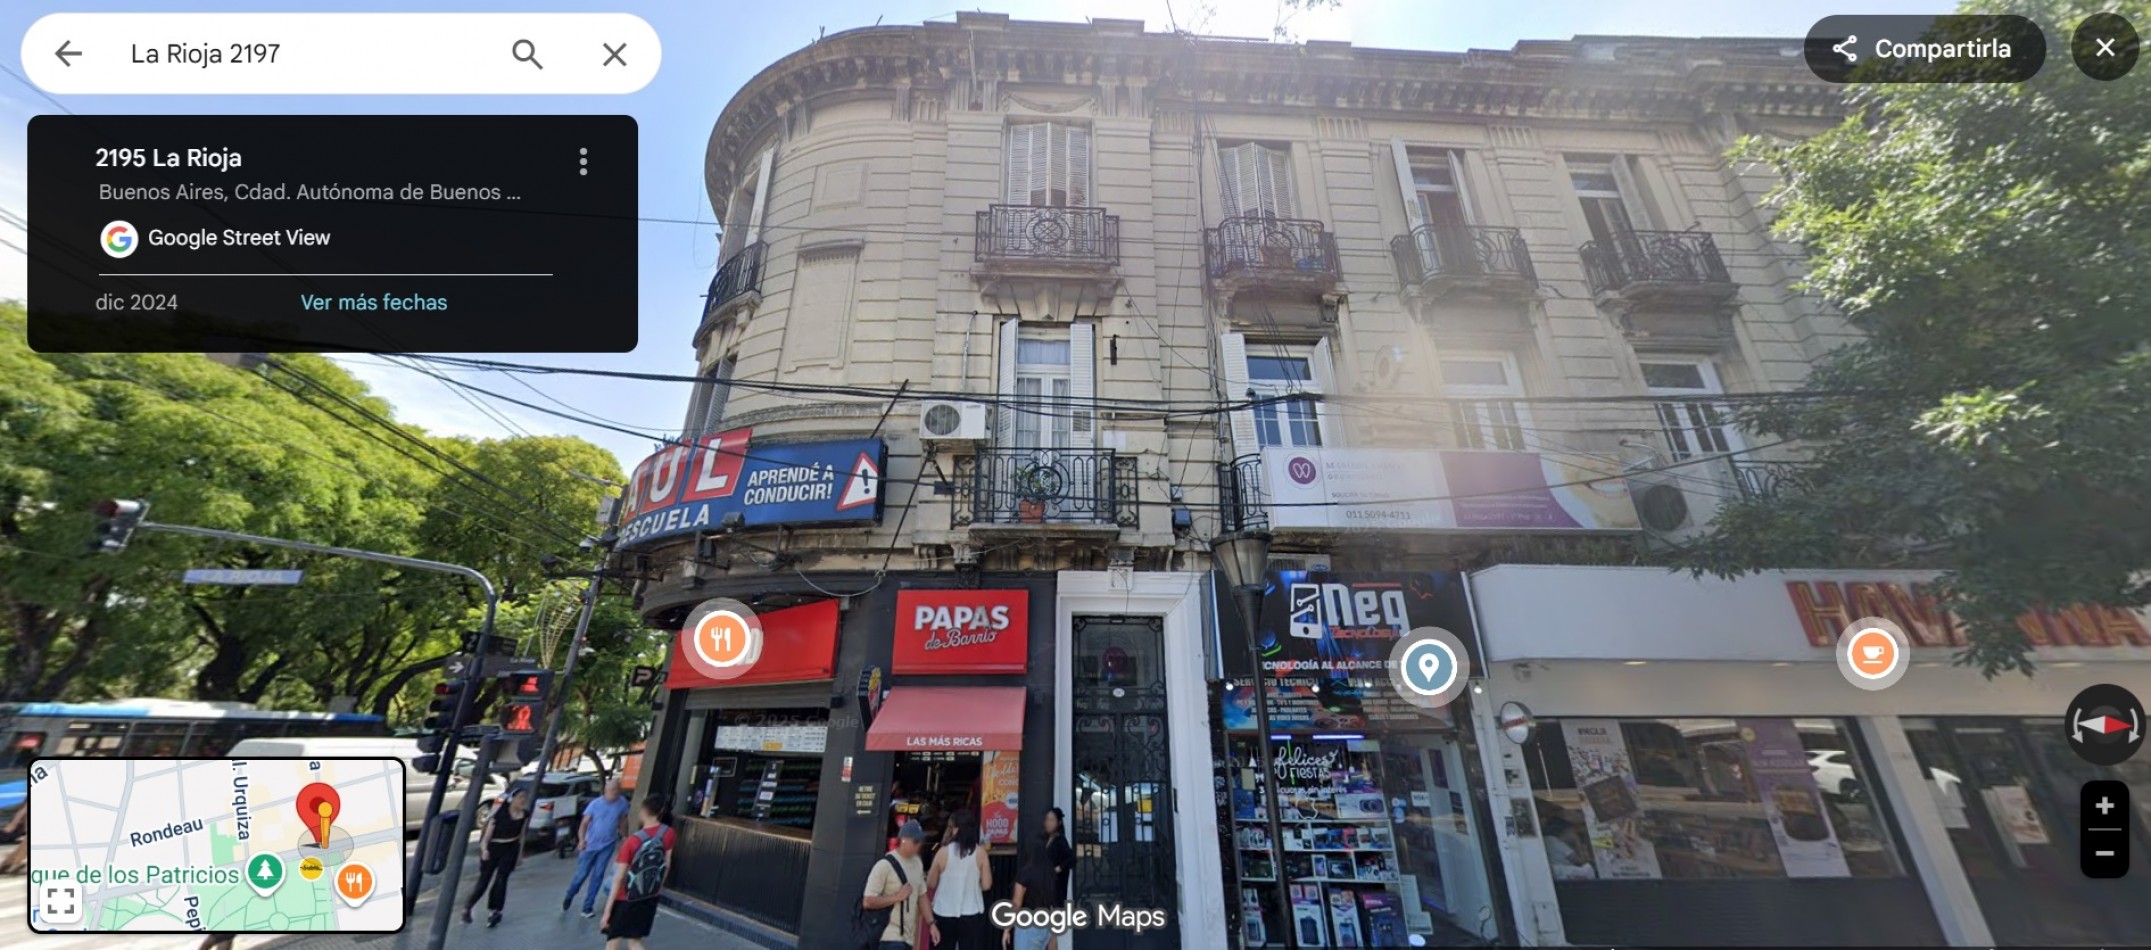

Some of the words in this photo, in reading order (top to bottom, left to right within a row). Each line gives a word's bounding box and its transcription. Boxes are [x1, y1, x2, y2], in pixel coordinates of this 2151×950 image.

[747, 462, 820, 488] APRENDÉ
[821, 465, 834, 481] A
[744, 483, 832, 505] CONDUCIR!
[914, 605, 1010, 631] PAPAS
[924, 630, 943, 650] de
[942, 628, 998, 648] Barrio
[1321, 661, 1335, 670] AL
[1336, 660, 1383, 670] ALCANCE
[906, 737, 927, 747] LAS
[928, 735, 951, 747] MÁS
[952, 736, 983, 747] RICAS
[1274, 746, 1338, 780] felices
